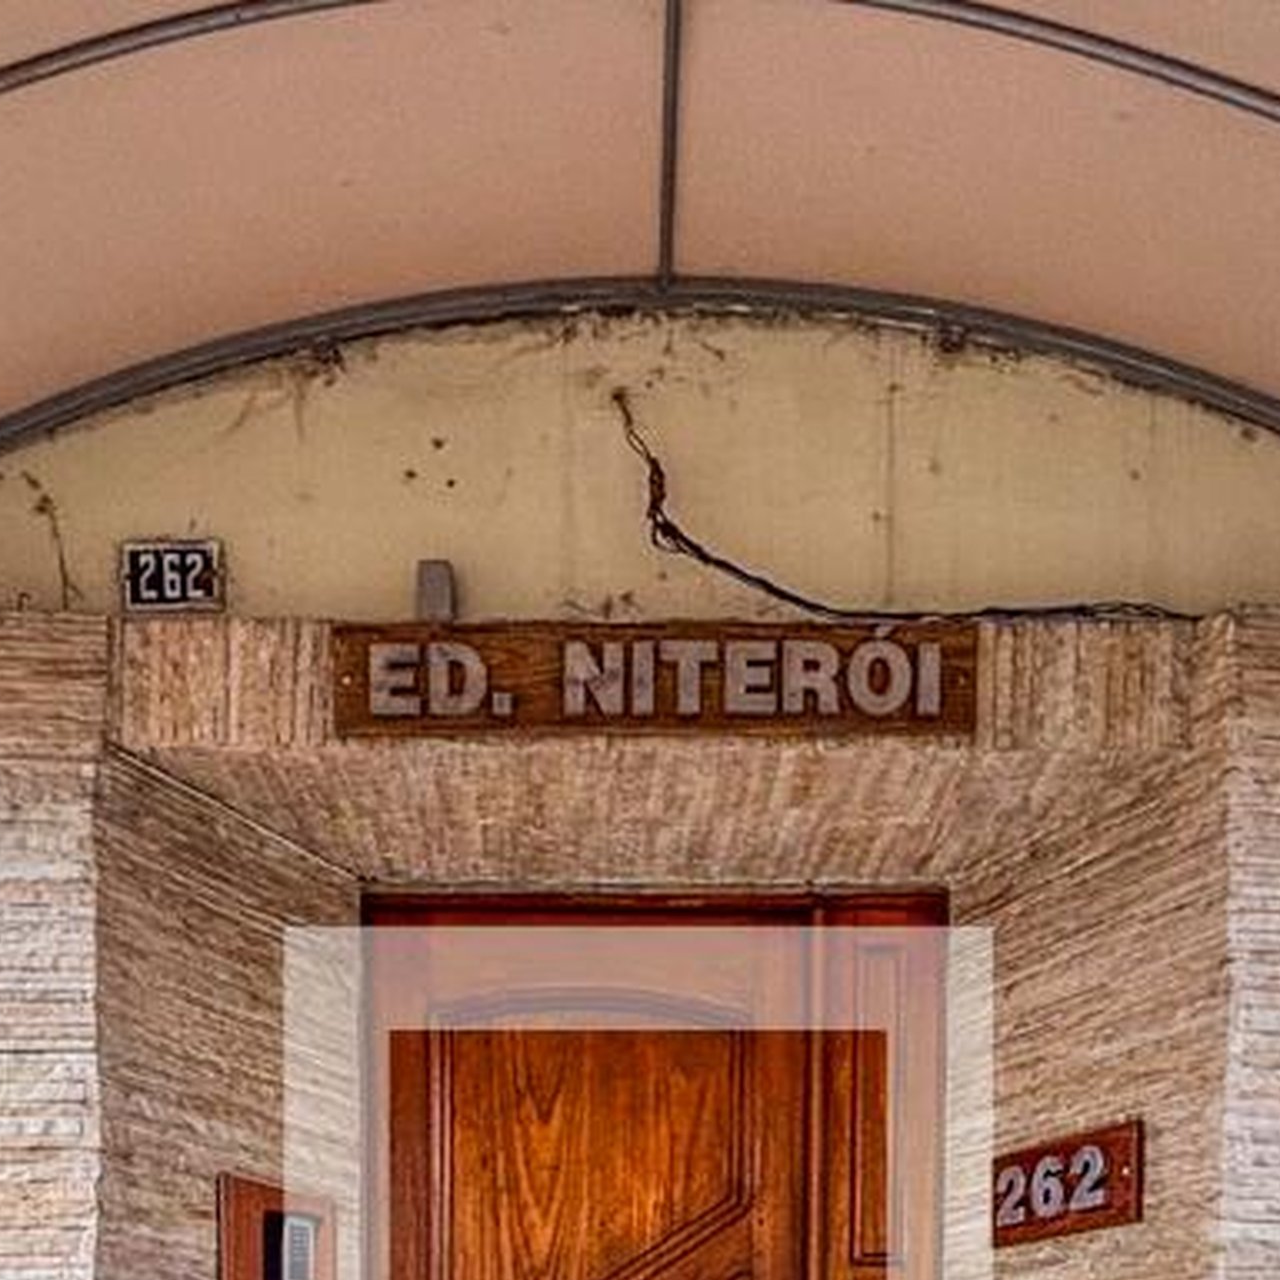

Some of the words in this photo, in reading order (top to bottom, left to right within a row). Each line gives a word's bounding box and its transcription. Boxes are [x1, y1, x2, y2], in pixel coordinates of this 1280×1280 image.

[139, 552, 206, 600] 262
[368, 641, 517, 717] ED.
[563, 626, 942, 717] NITERÓI
[996, 1145, 1106, 1228] 262
